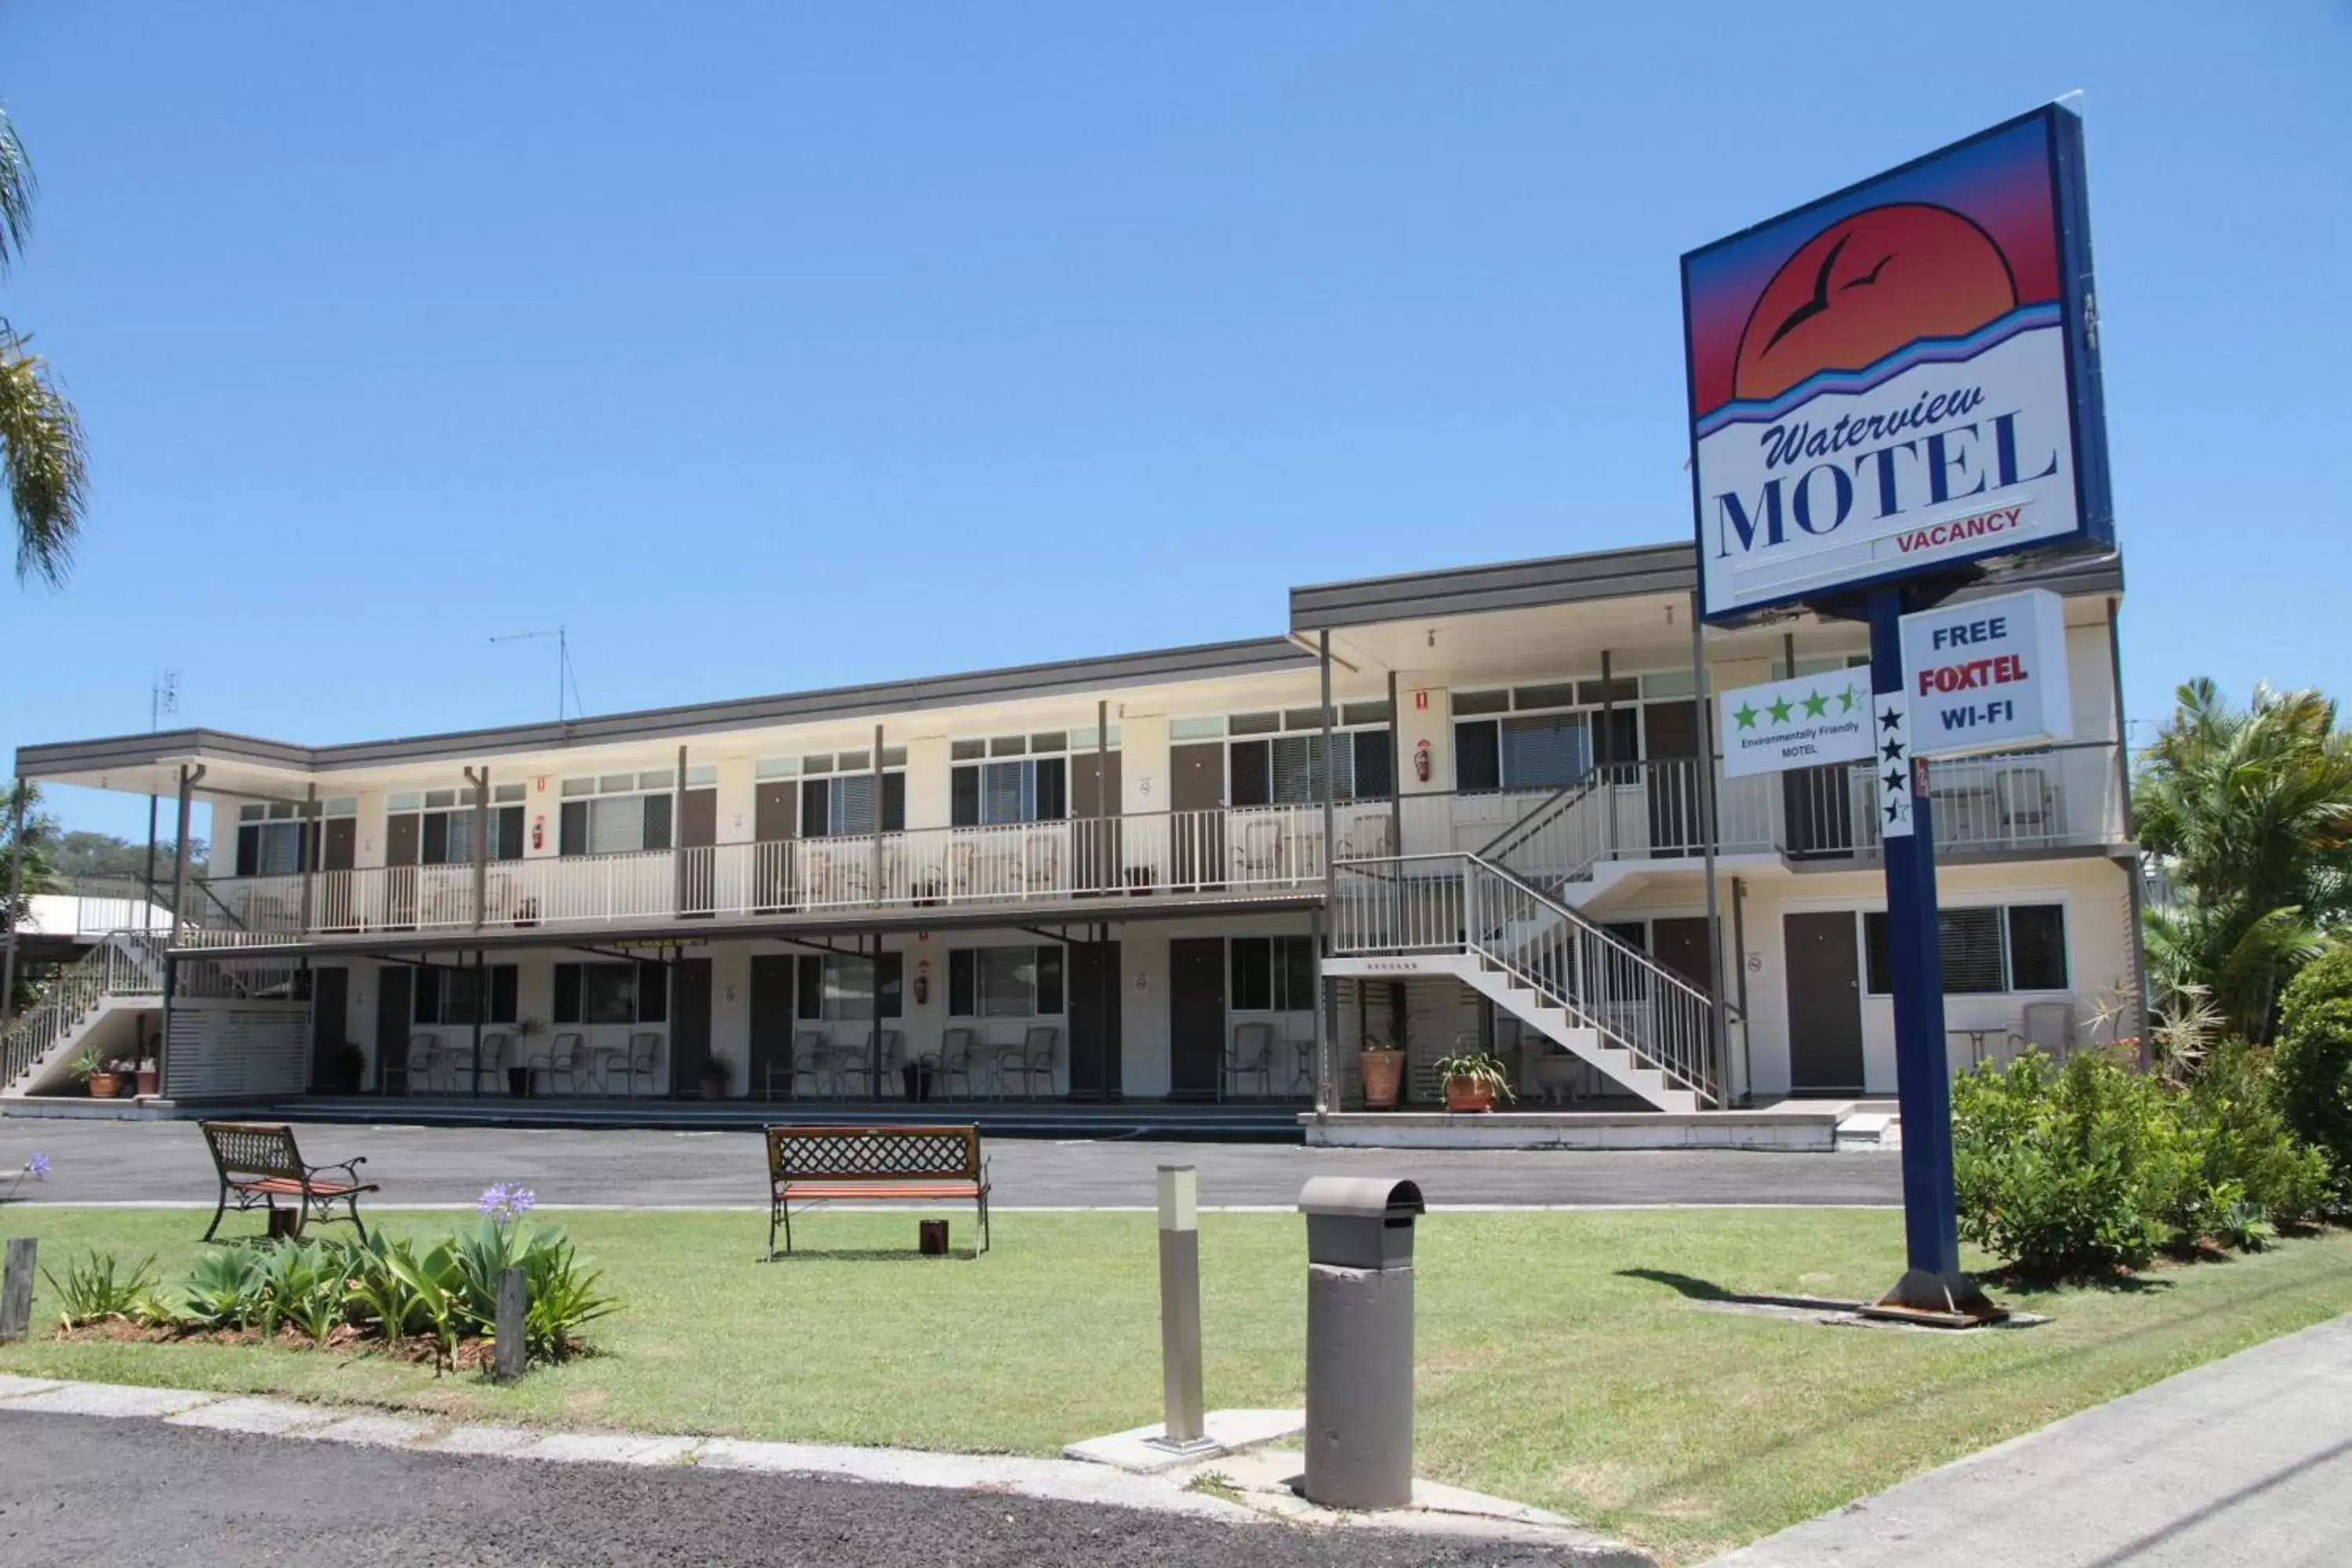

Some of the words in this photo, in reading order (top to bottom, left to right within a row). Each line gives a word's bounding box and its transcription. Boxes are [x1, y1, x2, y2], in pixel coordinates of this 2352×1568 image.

[1760, 387, 1985, 470] Waterview
[1712, 409, 2057, 559] MOTEL
[1896, 508, 2022, 553] VACANCY
[1933, 616, 2007, 650] FREE
[1918, 654, 2029, 696] FOXTEL
[1741, 728, 1816, 748] Environmentally
[1819, 721, 1859, 733] Friendly
[1940, 700, 2013, 731] WI-FI
[1782, 745, 1818, 758] MOTEL
